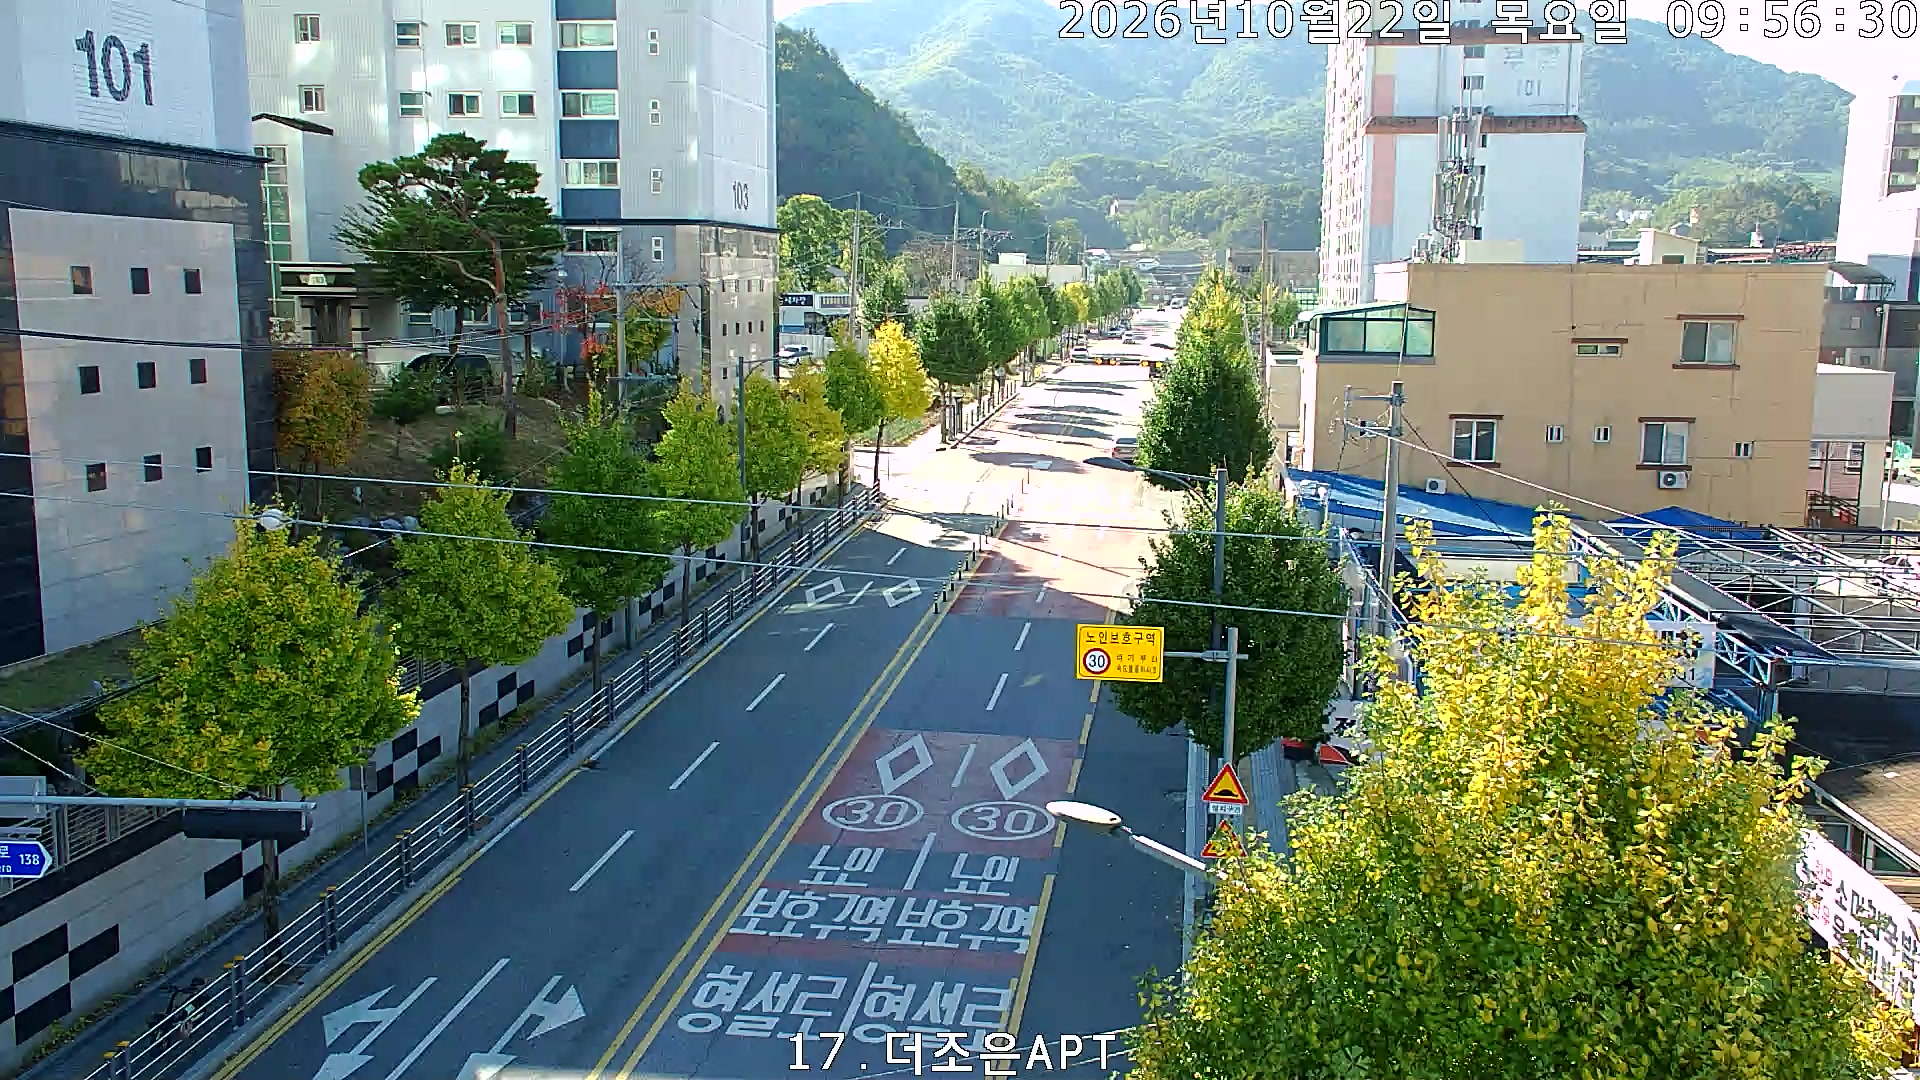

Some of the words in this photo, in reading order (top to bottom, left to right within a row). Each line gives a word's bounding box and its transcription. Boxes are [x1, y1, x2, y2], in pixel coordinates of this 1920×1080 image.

[75, 28, 153, 106] 101
[732, 180, 748, 210] 103
[1085, 631, 1156, 646] 노인보호구역
[1088, 654, 1105, 668] 30
[836, 800, 911, 826] 30
[966, 806, 1038, 834] 30
[19, 853, 40, 865] 138
[799, 844, 885, 888] 노인
[943, 852, 1020, 896] 노인
[729, 887, 897, 942] 보호구역
[887, 897, 1040, 954] 보호구역
[676, 964, 848, 1039] 형설로
[852, 974, 1016, 1051] 형설로
